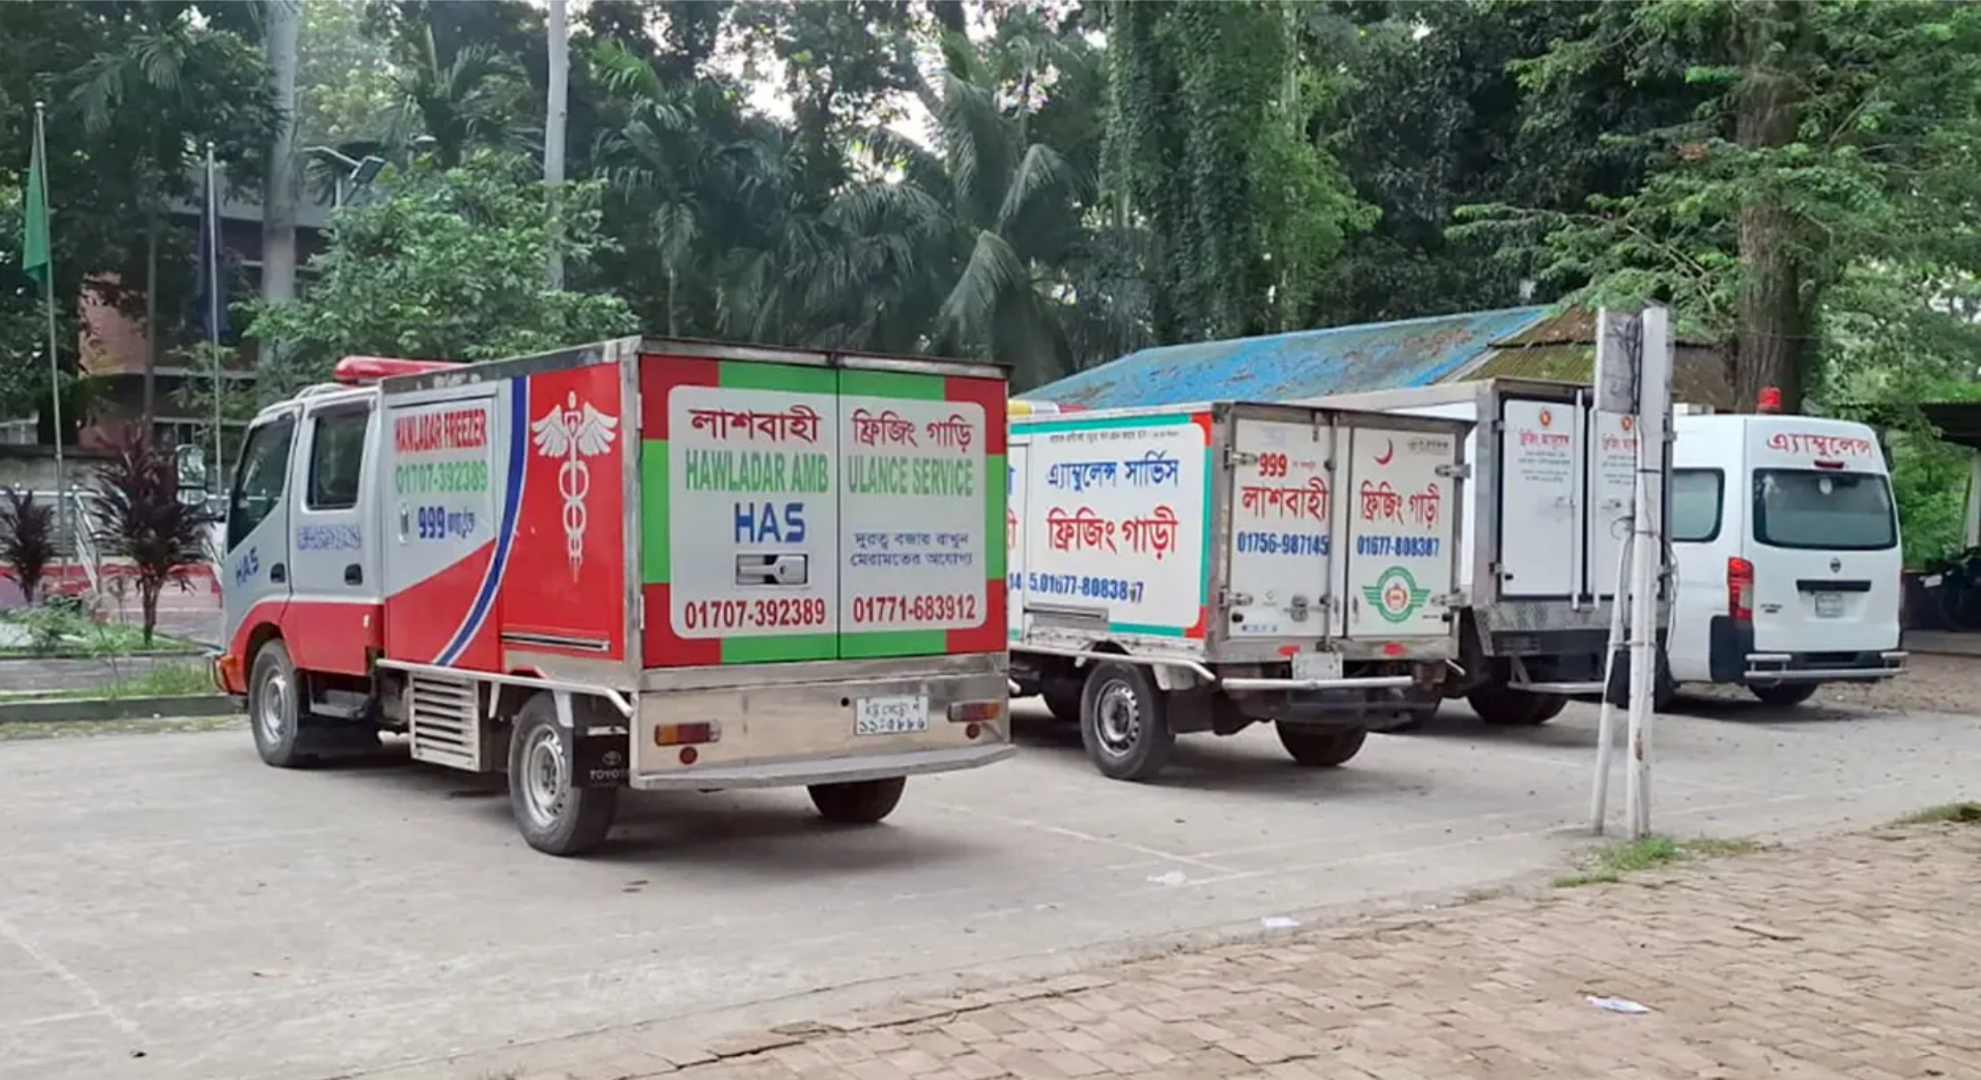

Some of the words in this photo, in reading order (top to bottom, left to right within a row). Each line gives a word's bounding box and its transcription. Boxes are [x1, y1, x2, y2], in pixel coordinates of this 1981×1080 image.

[443, 408, 488, 449] FREEZER
[687, 404, 823, 442] লাশবাহী
[851, 408, 919, 448] ফ্রিজিং
[926, 413, 974, 454] গাড়ি
[395, 459, 489, 494] 01707-392389
[685, 448, 786, 493] HAWLADAR
[912, 457, 973, 496] SERVICE
[1124, 450, 1180, 488] সার্ভিস
[1259, 452, 1287, 477] 999
[418, 505, 445, 539] 999
[734, 502, 806, 543] HAS
[1241, 476, 1330, 521] লাশবাহী
[1359, 480, 1404, 525] ফ্রিজিং
[1409, 483, 1441, 530] গাড়ী
[1046, 507, 1118, 554] ফ্রিজিং
[1121, 506, 1179, 561] গাড়ী
[1237, 531, 1330, 556] 01756-987145
[235, 546, 260, 586] HAS
[685, 598, 826, 630] 01707-392389
[853, 595, 976, 624] 01771-683912
